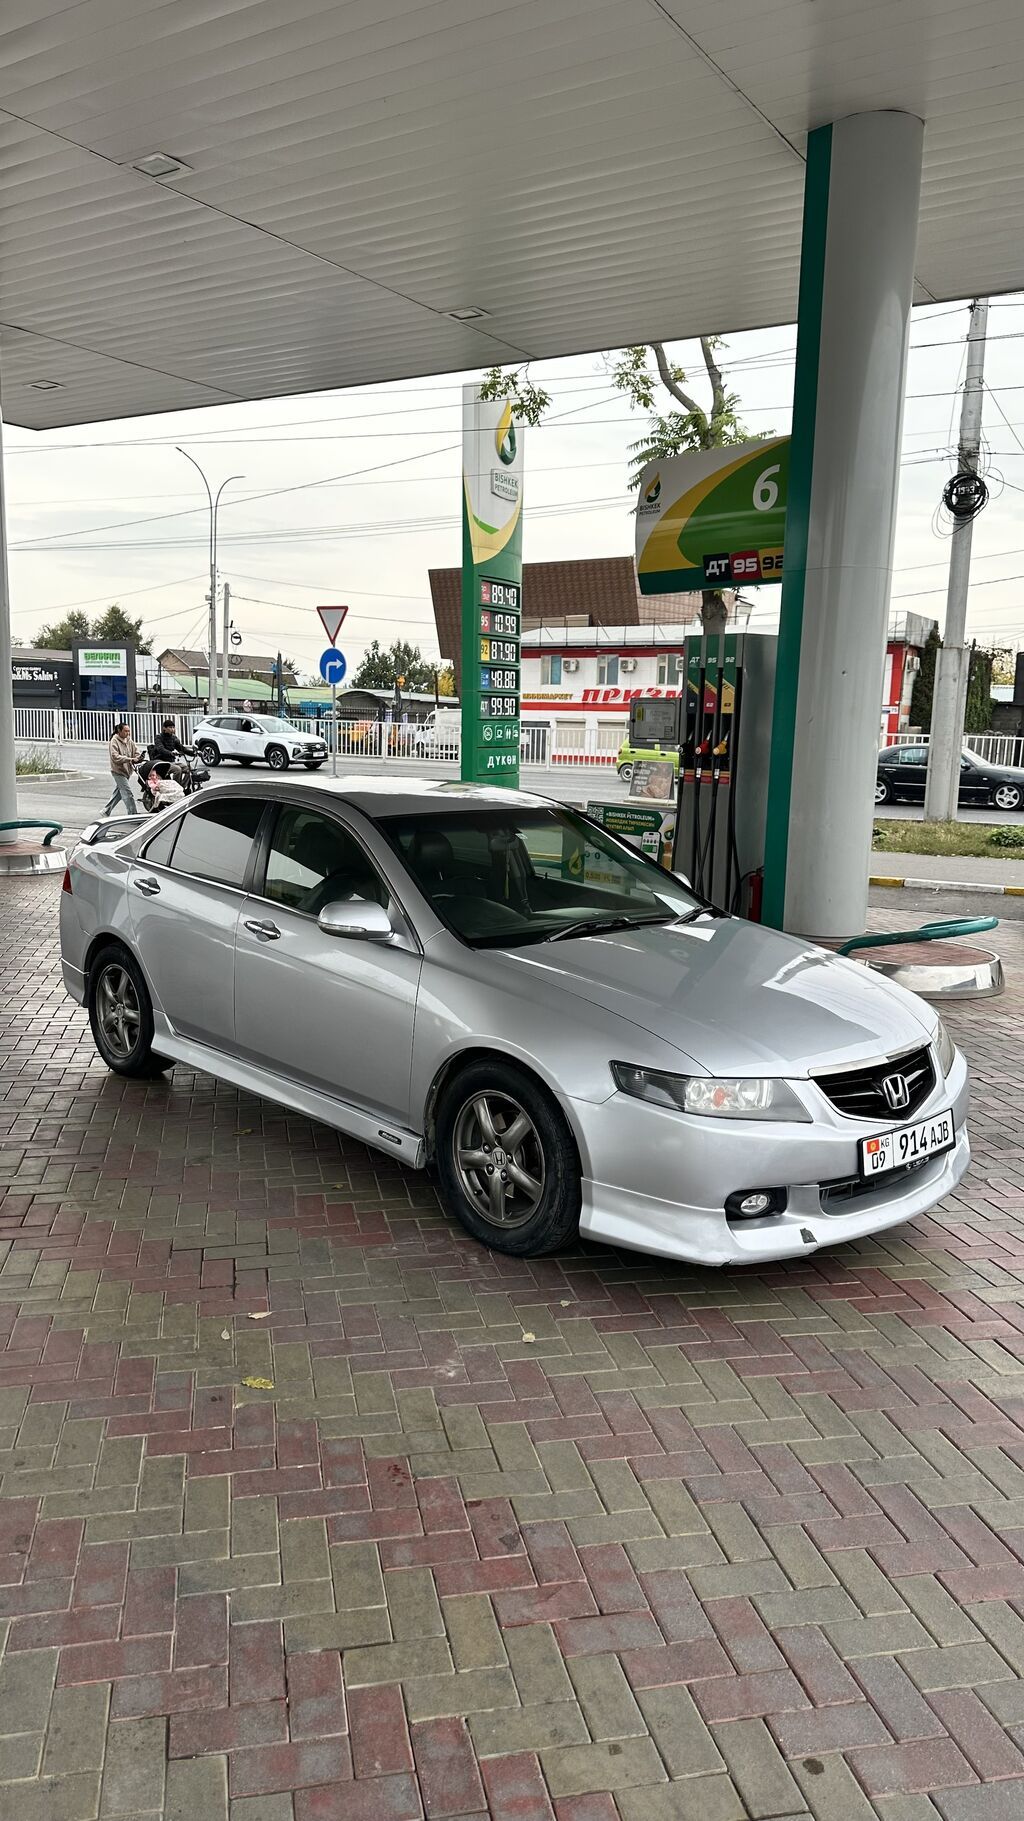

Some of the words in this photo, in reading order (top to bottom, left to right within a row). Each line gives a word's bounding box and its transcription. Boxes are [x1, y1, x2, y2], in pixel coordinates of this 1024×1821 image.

[494, 472, 518, 487] BISHKEK
[752, 464, 781, 511] 6
[639, 502, 661, 511] BISHKEK
[705, 559, 729, 577] ДТ
[733, 557, 758, 574] 95
[762, 554, 784, 571] 92
[491, 584, 517, 607] 89.40
[480, 615, 489, 627] 95
[480, 643, 489, 655] 92
[491, 641, 516, 662] 87.90
[491, 670, 516, 689] 48.80
[491, 697, 516, 716] 99.90
[487, 754, 517, 769] ДҮКӨН
[871, 1151, 886, 1170] 09
[899, 1126, 928, 1160] 914
[930, 1120, 949, 1148] AJB
[880, 1138, 890, 1148] KG
